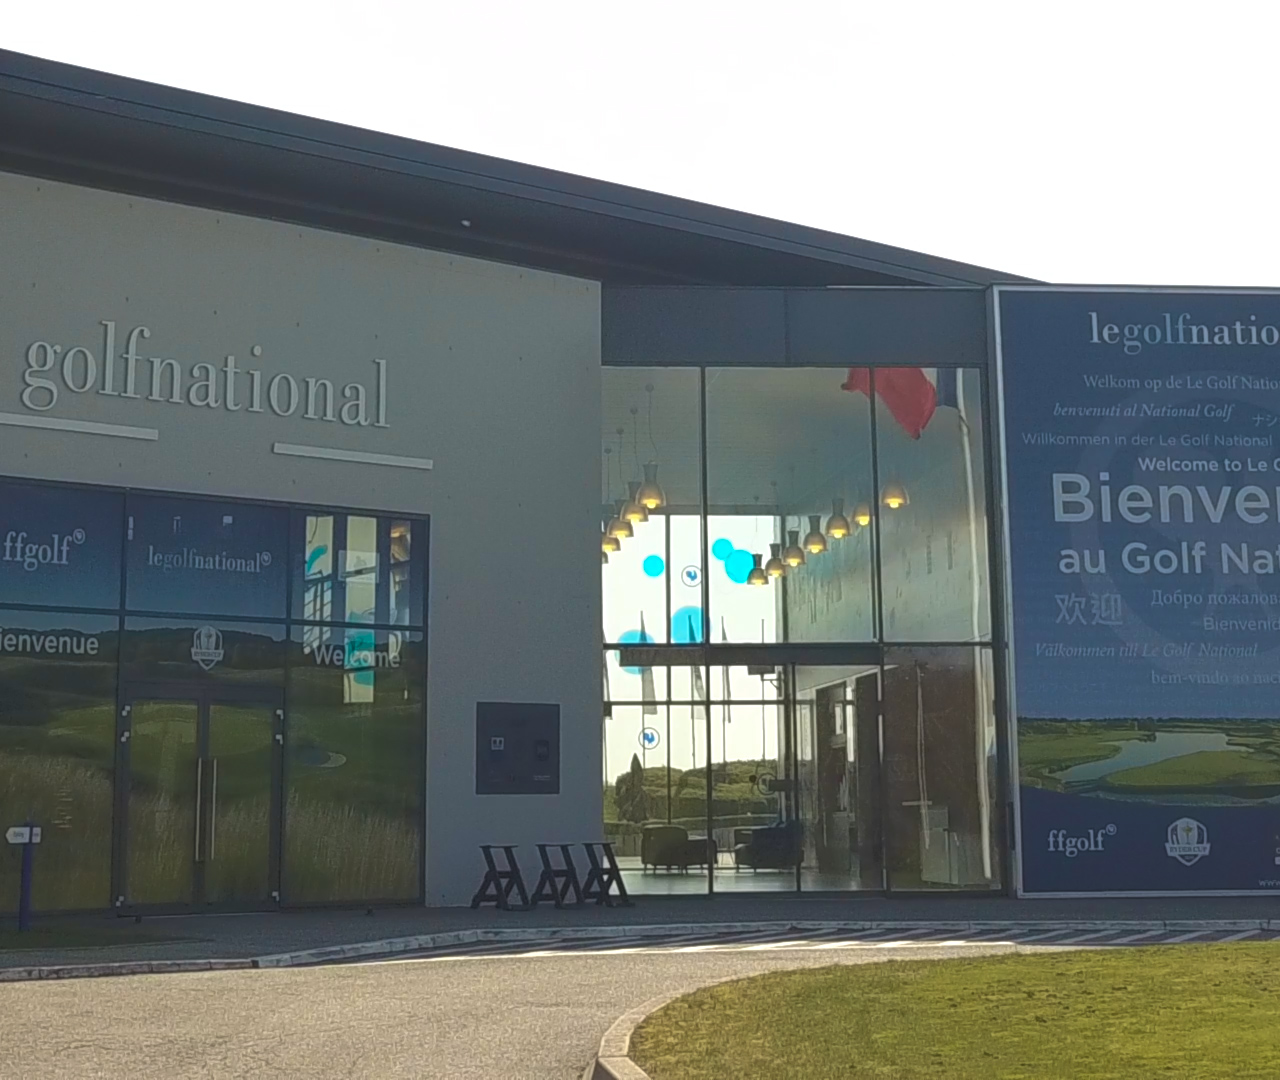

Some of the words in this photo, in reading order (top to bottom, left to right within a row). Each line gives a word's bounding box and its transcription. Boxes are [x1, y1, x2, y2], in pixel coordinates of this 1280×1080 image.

[21, 321, 389, 428] golfnational
[1083, 375, 1140, 389] Welkom
[1144, 378, 1163, 393] op
[1166, 375, 1183, 389] de
[1186, 376, 1203, 389] Le
[1206, 375, 1240, 390] Golf
[1053, 402, 1120, 417] benvenuti
[1124, 403, 1138, 417] al
[1140, 403, 1200, 418] National
[1203, 403, 1235, 422] Golf
[1022, 432, 1109, 446] Willkommen
[1114, 433, 1127, 446] in
[1131, 433, 1155, 447] der
[1159, 434, 1177, 447] Le
[1181, 433, 1210, 447] Golf
[1215, 434, 1273, 448] National
[1138, 456, 1218, 472] Welcome
[1224, 459, 1242, 472] to
[1247, 458, 1267, 472] Le
[2, 532, 71, 571] ffgolf
[1058, 547, 1106, 574] au
[1122, 541, 1207, 574] Golf
[1151, 589, 1203, 609] Добро
[313, 644, 401, 668] Welcome
[1163, 643, 1195, 658] Golf
[1199, 643, 1258, 658] National
[1048, 829, 1105, 857] ffgolf
